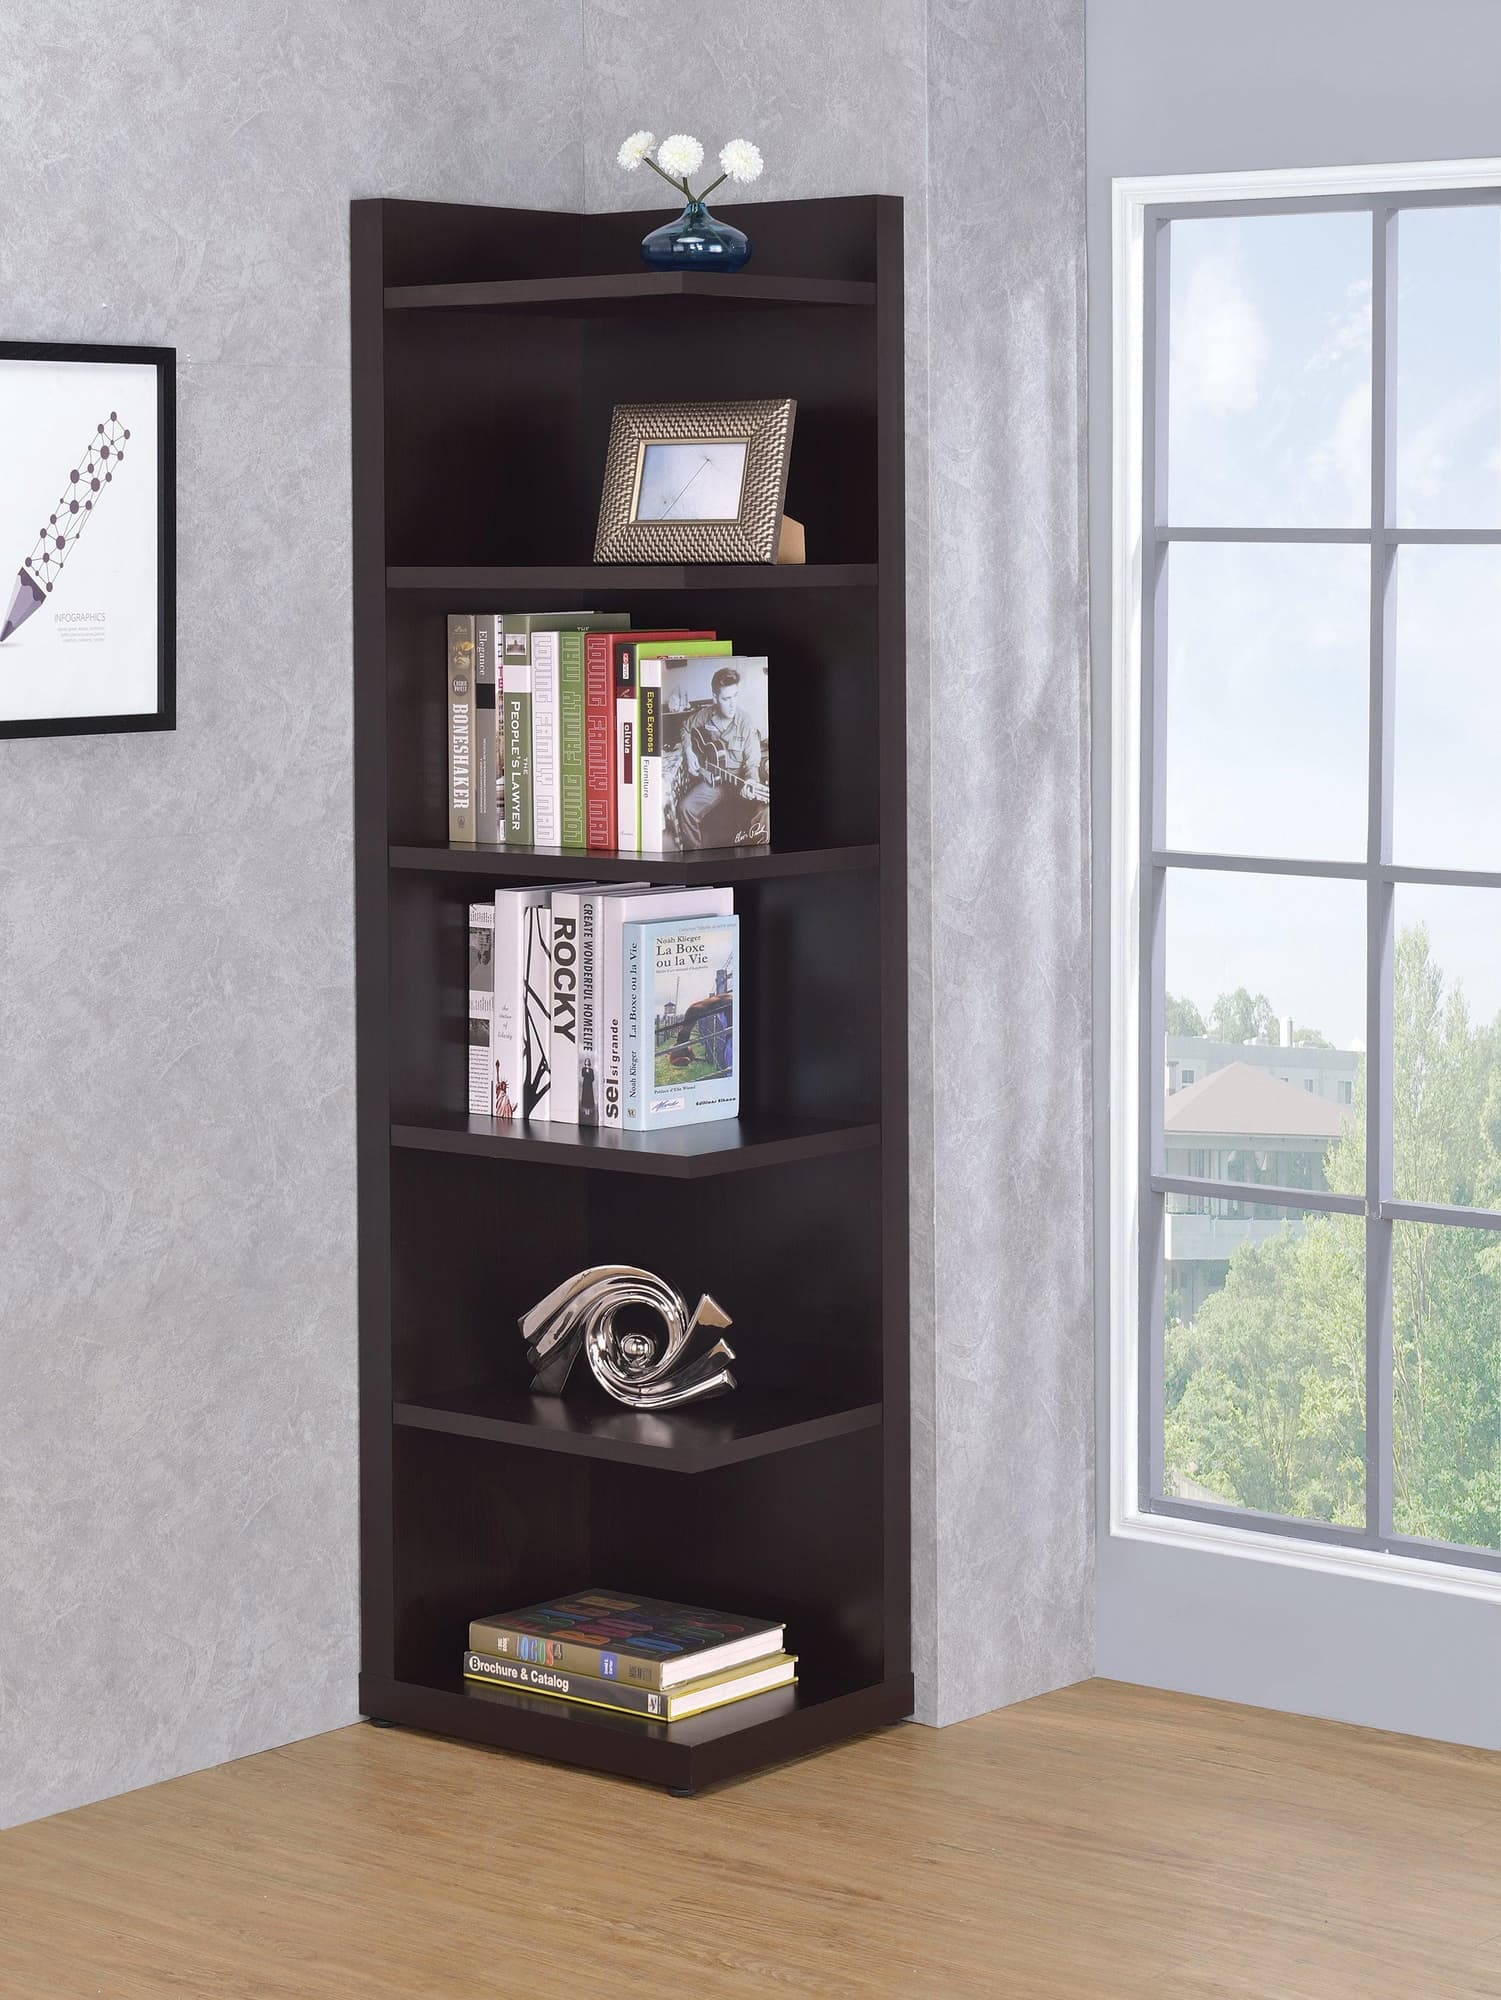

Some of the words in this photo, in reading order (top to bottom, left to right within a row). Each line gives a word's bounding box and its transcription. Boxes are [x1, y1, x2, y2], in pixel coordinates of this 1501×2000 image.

[54, 612, 106, 623] INFOGRAPHICS
[479, 630, 488, 676] Elegance
[562, 636, 582, 683] MAN
[510, 701, 521, 768] PEOPLE'S
[535, 711, 554, 786] FAMILY
[564, 691, 582, 766] FAMILY
[452, 703, 469, 809] BONESHAKER
[588, 715, 608, 791] FAMILY
[511, 771, 521, 831] LAWYER
[536, 794, 555, 841] MAN
[589, 799, 609, 846] MAN
[583, 903, 594, 939] CREATE
[677, 935, 702, 943] Klieger
[629, 942, 638, 960] Vie
[630, 964, 638, 974] la
[656, 946, 672, 956] La
[676, 943, 705, 954] Boxe
[656, 959, 671, 968] ou
[675, 956, 686, 966] la
[688, 953, 708, 964] Vie
[553, 917, 577, 1044] ROCKY
[584, 940, 594, 1003] WONDERFUL
[630, 977, 638, 991] ou
[629, 994, 638, 1020] Boxe
[584, 1004, 594, 1052] HOMELIFE
[610, 1018, 620, 1062] grande
[629, 1024, 638, 1038] La
[611, 1066, 619, 1076] si
[629, 1050, 638, 1076] Klieger
[605, 1078, 619, 1119] sei
[629, 1078, 637, 1098] Noah
[468, 1655, 518, 1679] Brochure
[520, 1668, 528, 1681] &
[530, 1670, 569, 1693] Catalog
